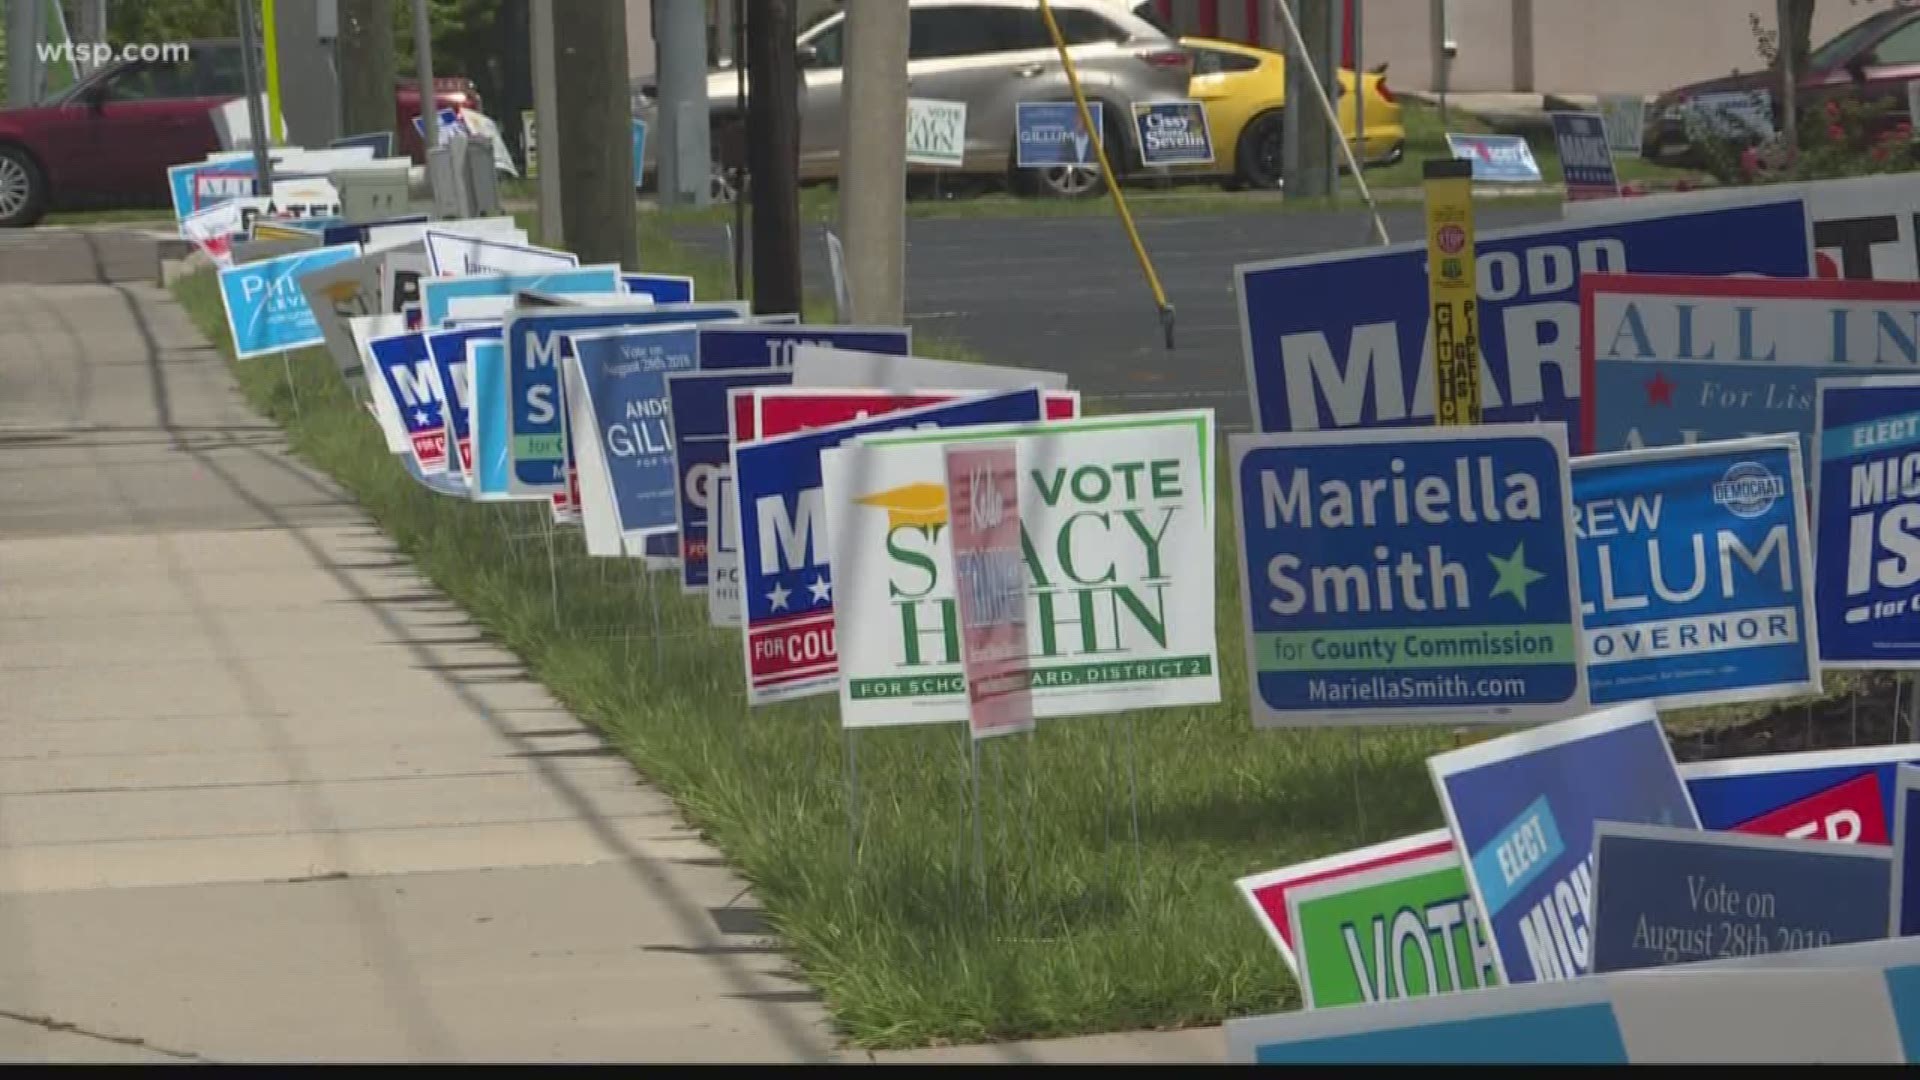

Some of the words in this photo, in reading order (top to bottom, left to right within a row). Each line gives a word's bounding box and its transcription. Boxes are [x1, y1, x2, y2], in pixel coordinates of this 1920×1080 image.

[1424, 239, 1627, 301] ODD
[1608, 301, 1776, 362] ALL
[1701, 381, 1752, 409] For
[1852, 416, 1917, 448] ELECT
[1031, 460, 1182, 507] VOTE
[1261, 457, 1542, 529] Mariella
[1715, 478, 1783, 502] DEMOCRAT
[886, 505, 1182, 598] SCY
[1582, 524, 1794, 615] LUM
[1267, 545, 1471, 615] Smith
[890, 580, 1172, 667] HHN
[1875, 599, 1907, 619] for
[756, 637, 785, 660] FOR
[1274, 635, 1305, 661] for
[1311, 636, 1396, 663] County
[1404, 629, 1554, 658] Commission
[861, 682, 901, 698] FOR
[1086, 661, 1182, 683] DISTRICT
[1190, 660, 1201, 675] 2
[1308, 674, 1526, 703] MariellaSmith.com
[1497, 815, 1547, 887] ELECT
[1687, 875, 1740, 918] Vote
[1746, 894, 1776, 919] on
[1632, 912, 1712, 963] August
[1720, 920, 1769, 958] 28th
